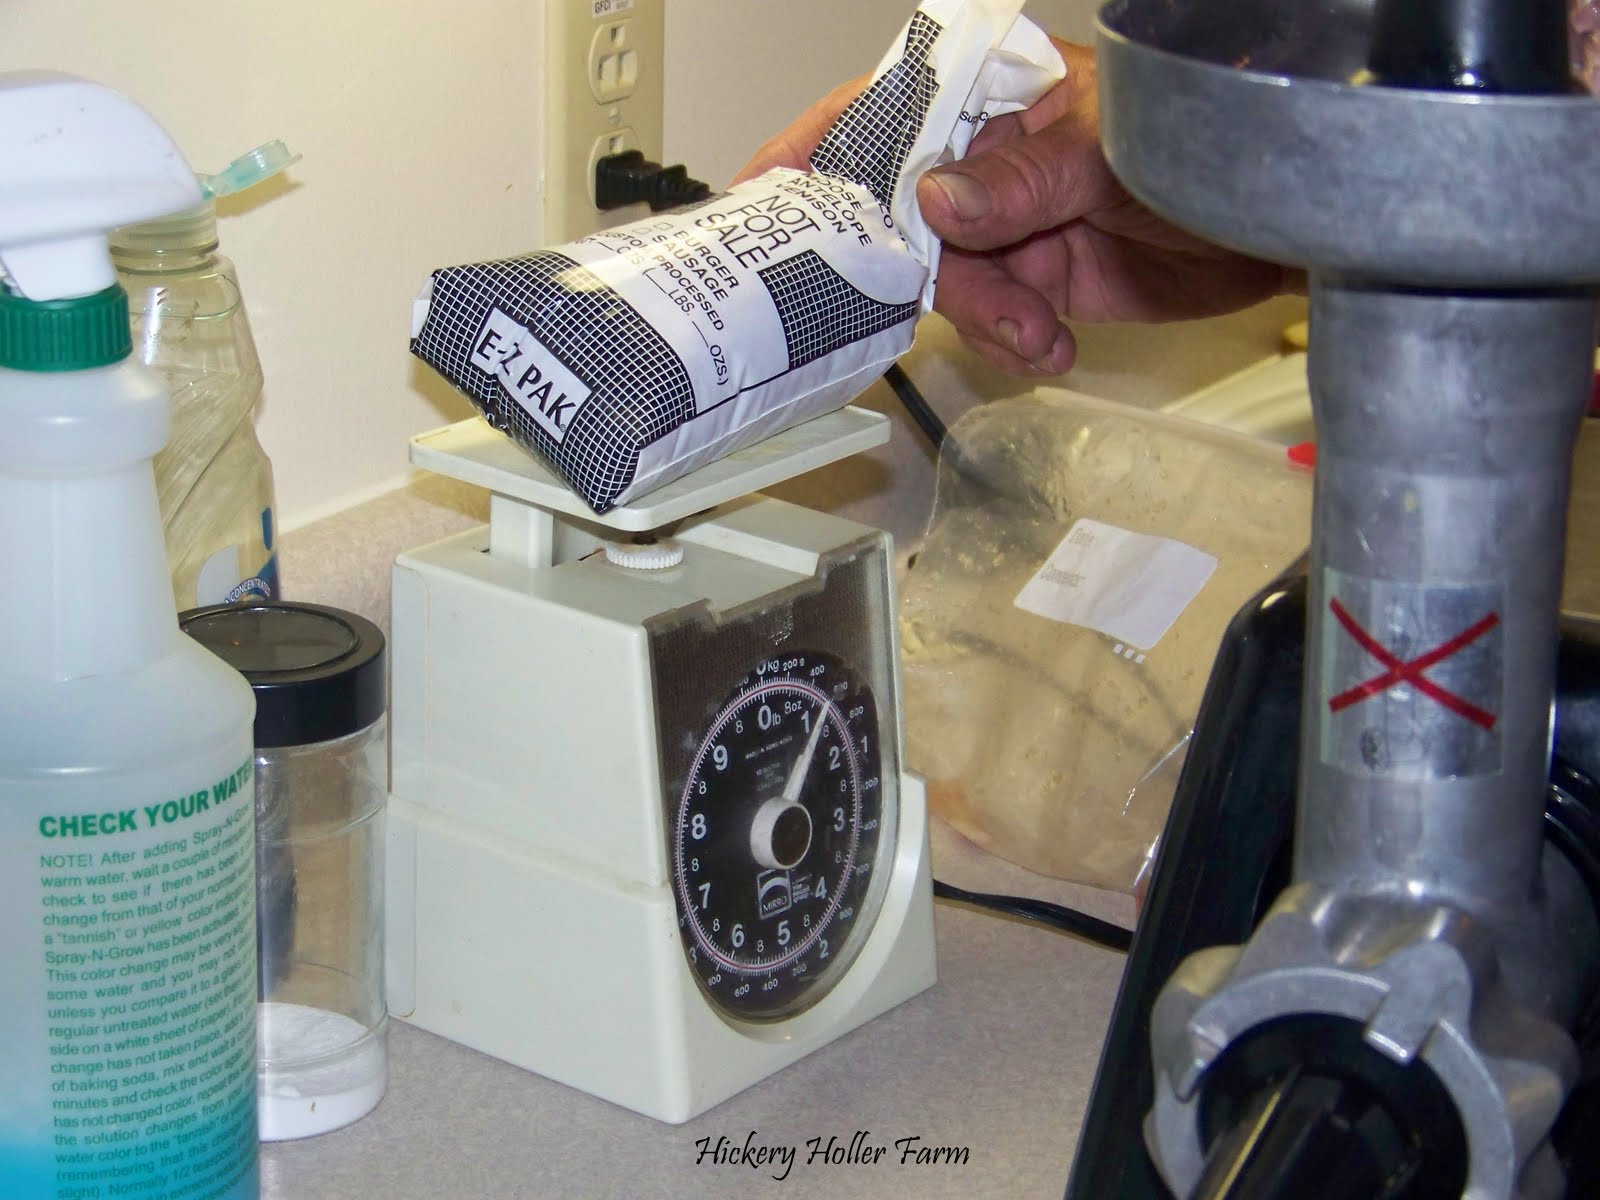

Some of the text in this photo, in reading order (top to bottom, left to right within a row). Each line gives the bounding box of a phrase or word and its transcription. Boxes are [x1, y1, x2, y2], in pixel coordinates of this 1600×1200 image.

[757, 194, 821, 235] NOT
[788, 177, 873, 247] ANTELOPE
[695, 213, 770, 269] SALE
[728, 204, 792, 252] FOR
[653, 235, 729, 301] SAUSAGE
[653, 255, 725, 331] PROCESSED
[810, 665, 825, 677] 400
[735, 720, 743, 733] 8
[801, 710, 810, 734] 1
[861, 735, 868, 753] 1
[713, 745, 728, 771] 9
[829, 746, 841, 771] 2
[699, 780, 707, 794] 8
[840, 779, 847, 791] 8
[40, 809, 137, 837] CHECK
[144, 790, 209, 827] YOUR
[691, 813, 706, 840] 8
[833, 807, 846, 832] 3
[40, 839, 187, 868] NOTE! After adding
[691, 858, 700, 872] 8
[41, 877, 82, 887] warm
[132, 864, 159, 879] wait
[162, 864, 170, 874] a
[172, 849, 209, 871] couple
[43, 894, 86, 906] check
[92, 892, 106, 904] to
[112, 890, 137, 902] see
[143, 883, 151, 896] if
[162, 876, 192, 892] there
[197, 866, 216, 880] has
[699, 882, 712, 909] 7
[815, 876, 828, 899] 4
[43, 912, 98, 928] change
[101, 910, 134, 922] from
[138, 901, 163, 917] that
[166, 896, 178, 911] of
[180, 889, 205, 909] your
[762, 895, 788, 912] MIRRO
[44, 935, 53, 945] a
[124, 929, 137, 939] or
[143, 916, 182, 938] yellow
[187, 904, 214, 922] color
[713, 918, 720, 932] 8
[777, 920, 791, 945] 5
[803, 914, 811, 927] 8
[45, 929, 200, 966] Spray-N-Grow has been
[731, 923, 745, 948] 6
[757, 939, 764, 953] 8
[819, 939, 829, 959] 2
[47, 969, 76, 981] This
[81, 967, 116, 981] color
[119, 959, 169, 977] change
[172, 948, 197, 965] may
[47, 990, 87, 1001] some
[95, 984, 133, 998] water
[141, 975, 165, 991] and
[172, 969, 193, 986] you
[198, 959, 219, 973] may
[734, 983, 750, 998] 600
[48, 1006, 96, 1019] unless
[100, 1004, 126, 1020] you
[130, 990, 187, 1012] compare
[49, 1024, 99, 1040] regular
[103, 1011, 168, 1034] untreated
[170, 1001, 202, 1020] water
[50, 1044, 79, 1056] side
[82, 1044, 100, 1055] on
[103, 1043, 112, 1053] a
[115, 1037, 150, 1051] white
[153, 1024, 186, 1044] sheet
[51, 1061, 103, 1076] change
[107, 1058, 132, 1071] has
[135, 1051, 156, 1067] not
[158, 1043, 192, 1061] taken
[52, 1079, 65, 1092] of
[70, 1077, 118, 1093] baking
[163, 1063, 184, 1078] mix
[187, 1052, 209, 1070] and
[53, 1063, 223, 1110] minutes and check the color
[54, 1115, 80, 1129] has
[82, 1115, 104, 1128] not
[106, 1104, 163, 1124] changed
[55, 1133, 78, 1146] the
[83, 1129, 140, 1145] solution
[145, 1112, 198, 1137] changes
[202, 1099, 224, 1118] from
[56, 1152, 95, 1164] water
[97, 1148, 133, 1162] color
[135, 1144, 148, 1157] to
[150, 1139, 171, 1154] the
[160, 1151, 184, 1169] that
[108, 1174, 169, 1196] Normally
